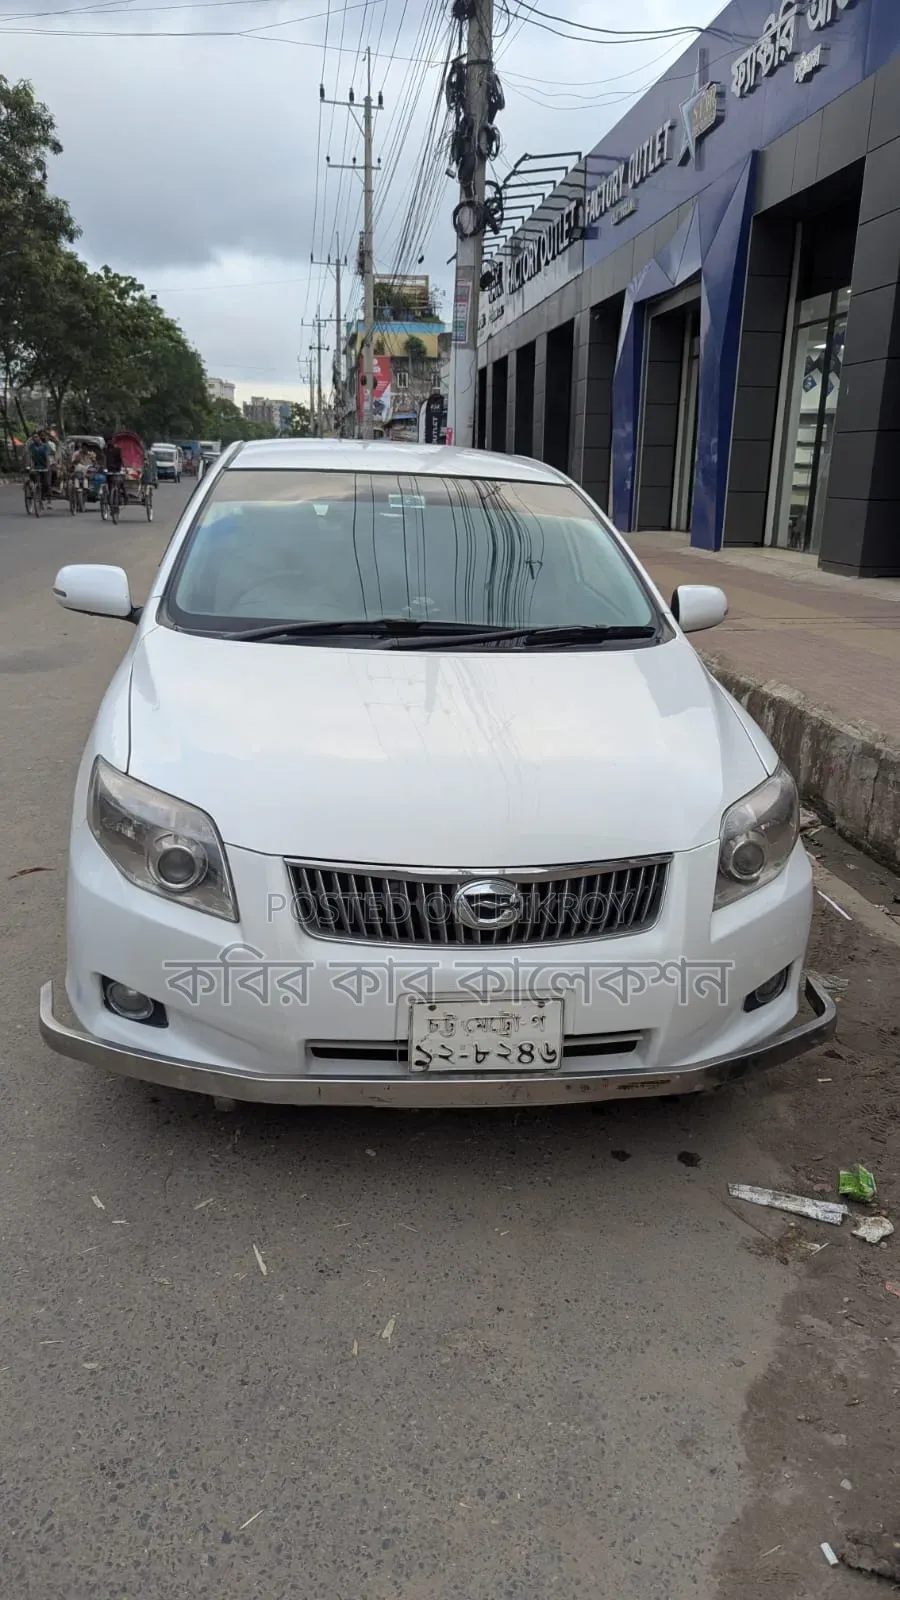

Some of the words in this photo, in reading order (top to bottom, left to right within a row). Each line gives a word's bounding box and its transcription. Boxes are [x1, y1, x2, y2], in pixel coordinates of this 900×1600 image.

[585, 163, 625, 228] FACTORY
[628, 119, 671, 190] OUTLET
[541, 199, 578, 264] OUTLET
